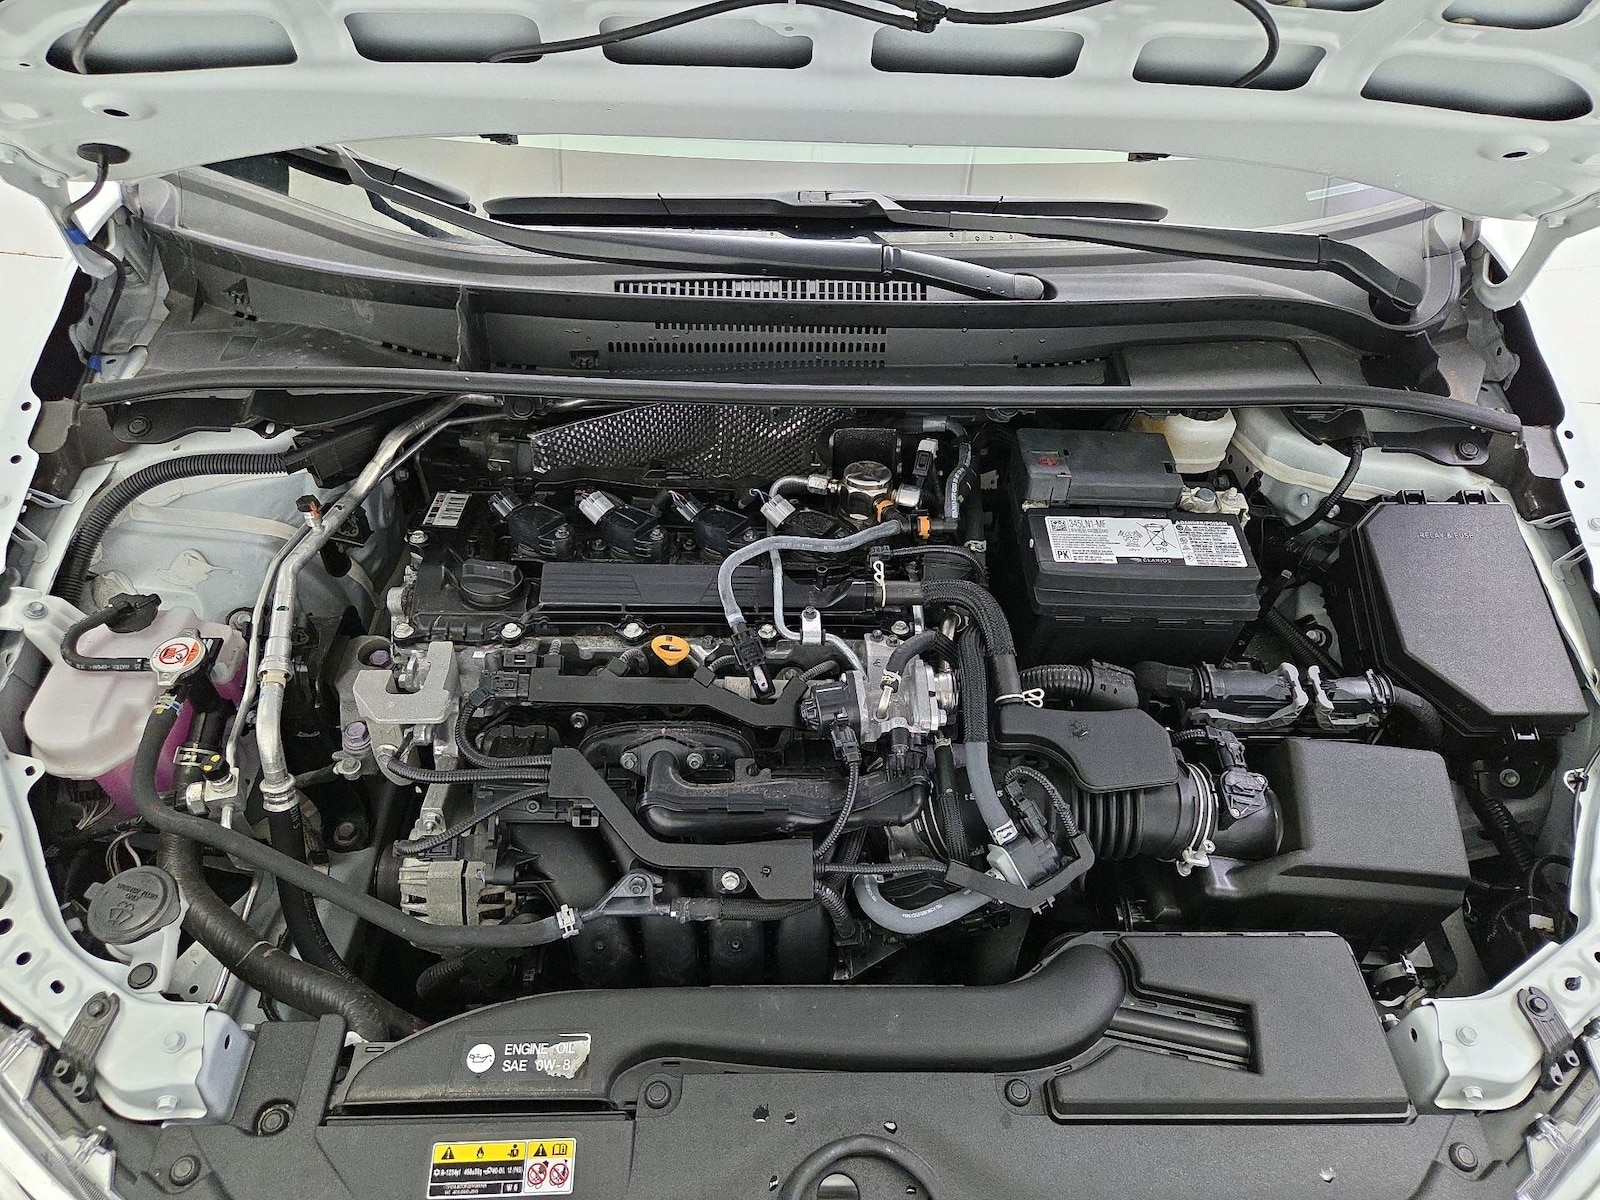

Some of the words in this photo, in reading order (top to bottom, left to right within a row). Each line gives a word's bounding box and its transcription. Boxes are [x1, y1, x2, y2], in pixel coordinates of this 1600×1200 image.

[1057, 550, 1070, 559] PK
[504, 1042, 549, 1055] ENGINE
[556, 1043, 576, 1054] OIL
[502, 1059, 528, 1072] SAE
[536, 1059, 571, 1072] 0W-8
